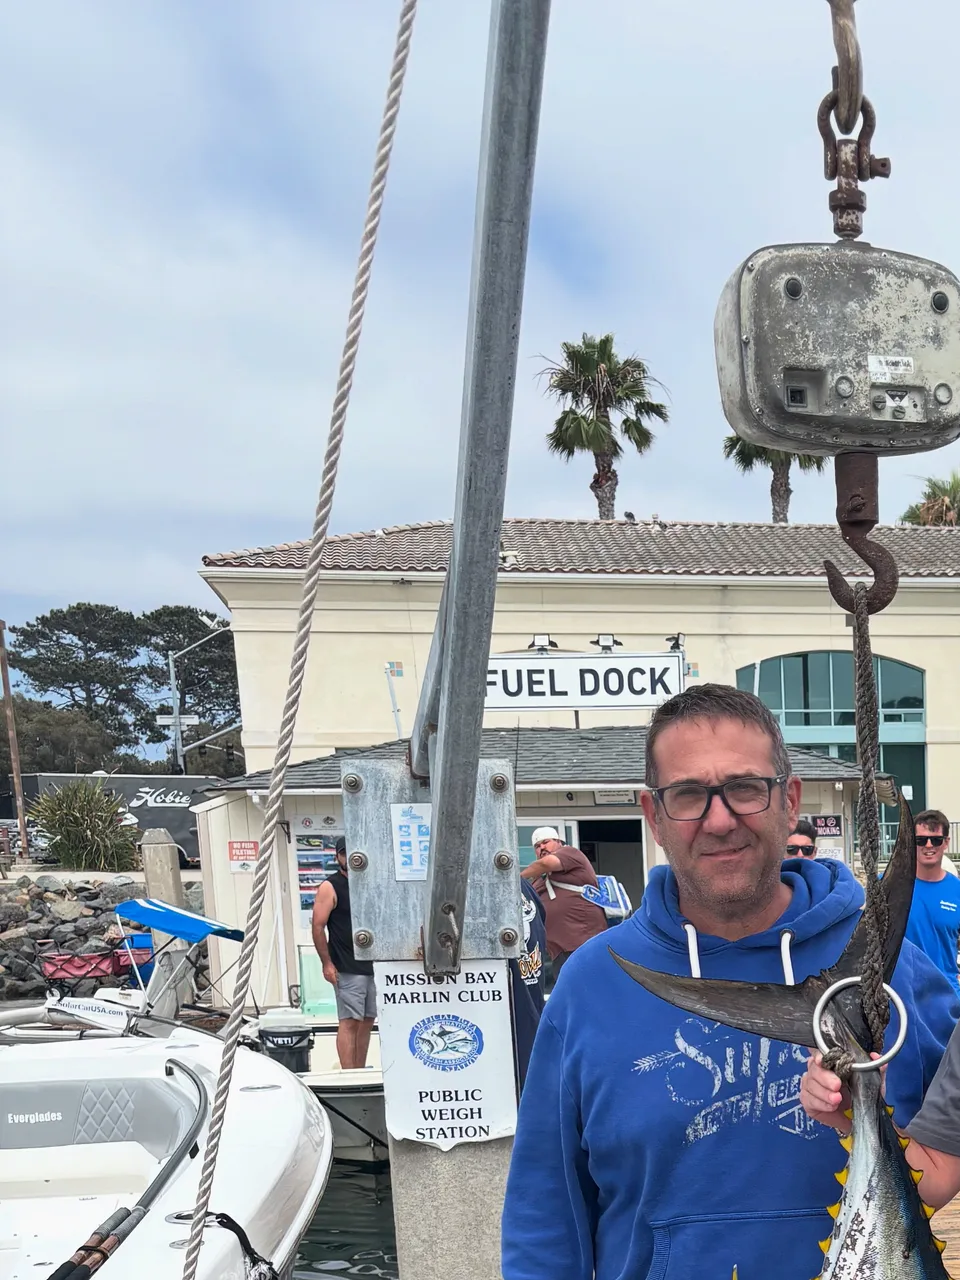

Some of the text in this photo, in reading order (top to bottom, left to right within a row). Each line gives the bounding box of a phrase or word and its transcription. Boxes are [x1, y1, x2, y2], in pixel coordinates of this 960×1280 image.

[486, 667, 672, 698] FUEL DOCK
[129, 787, 191, 807] Hobie
[816, 818, 825, 827] NO
[385, 972, 497, 986] MISSIN BAY
[383, 990, 502, 1005] MARLIN CLUB
[272, 1037, 292, 1045] YETI
[418, 1089, 483, 1103] PUBLIC
[7, 1111, 63, 1124] Everglades
[421, 1107, 483, 1121] WEIGH
[415, 1125, 490, 1140] STATION
